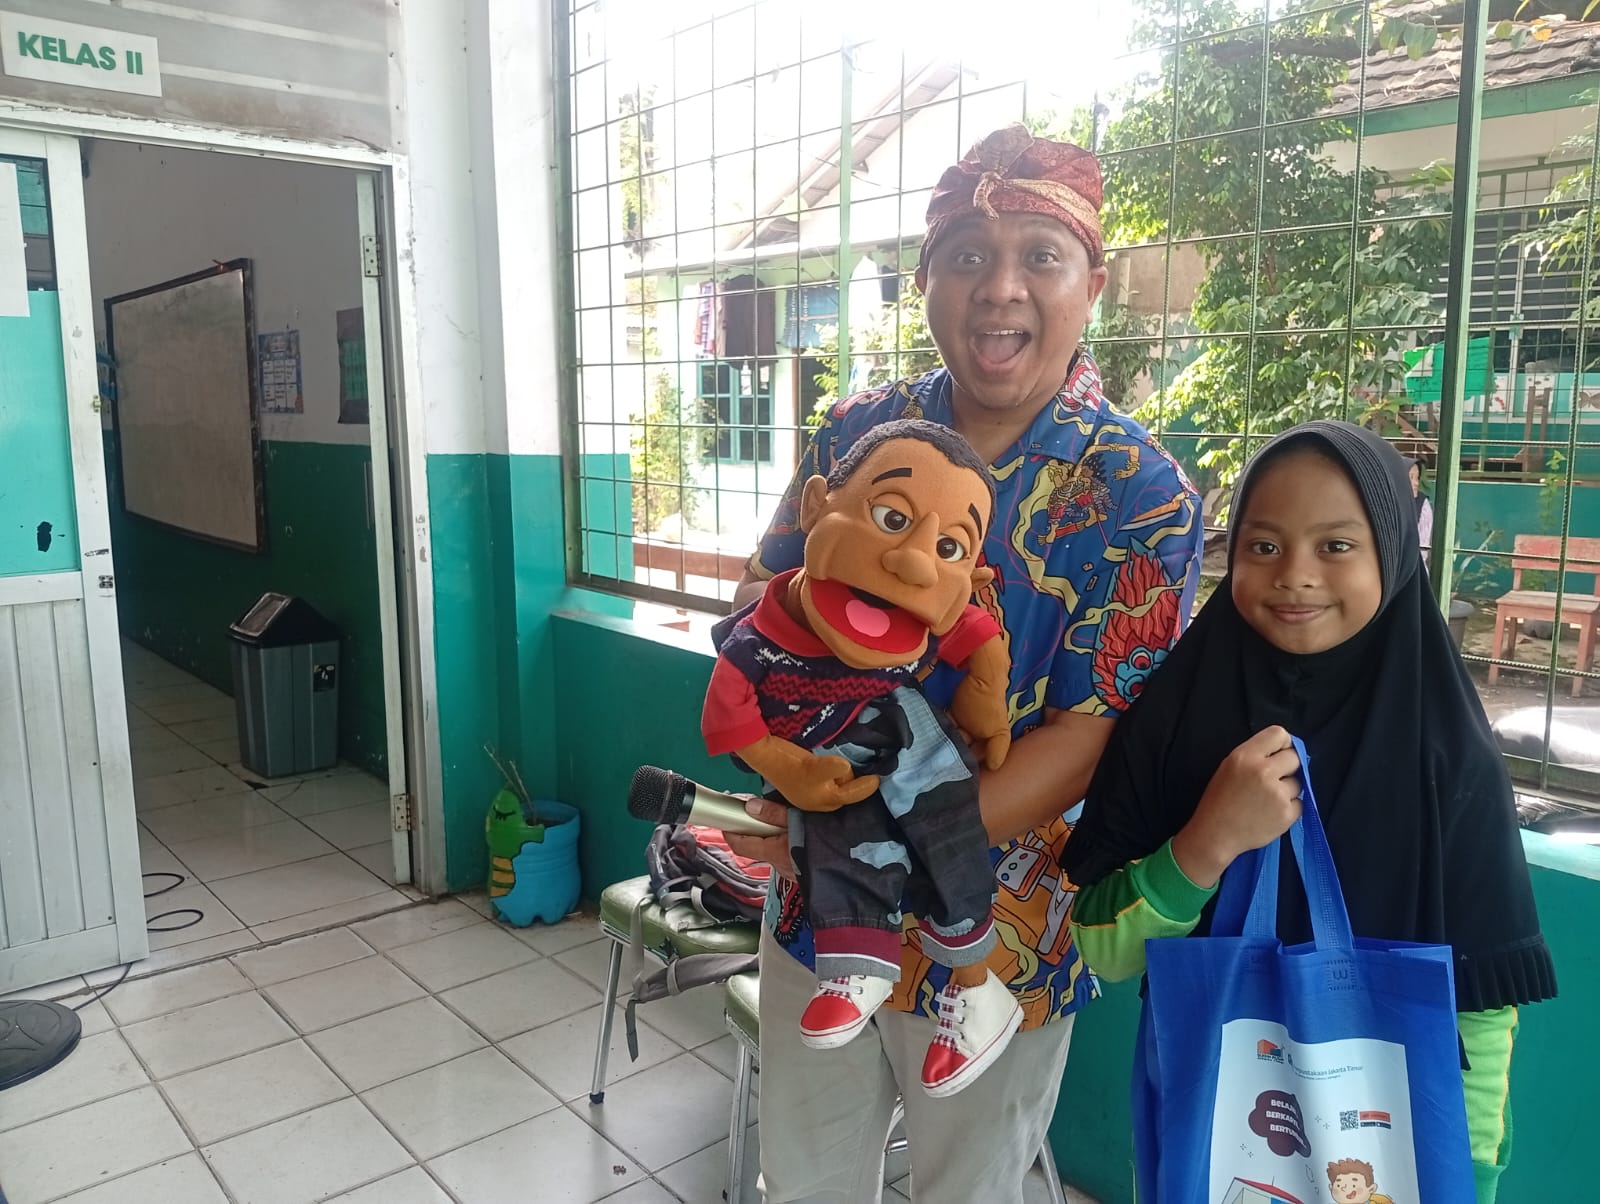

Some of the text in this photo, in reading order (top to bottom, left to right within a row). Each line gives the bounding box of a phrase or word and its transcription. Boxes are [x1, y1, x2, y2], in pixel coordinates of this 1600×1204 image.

[17, 31, 144, 75] KELAS II
[1271, 1099, 1299, 1119] BELAJ
[1265, 1110, 1300, 1130] BERKAR
